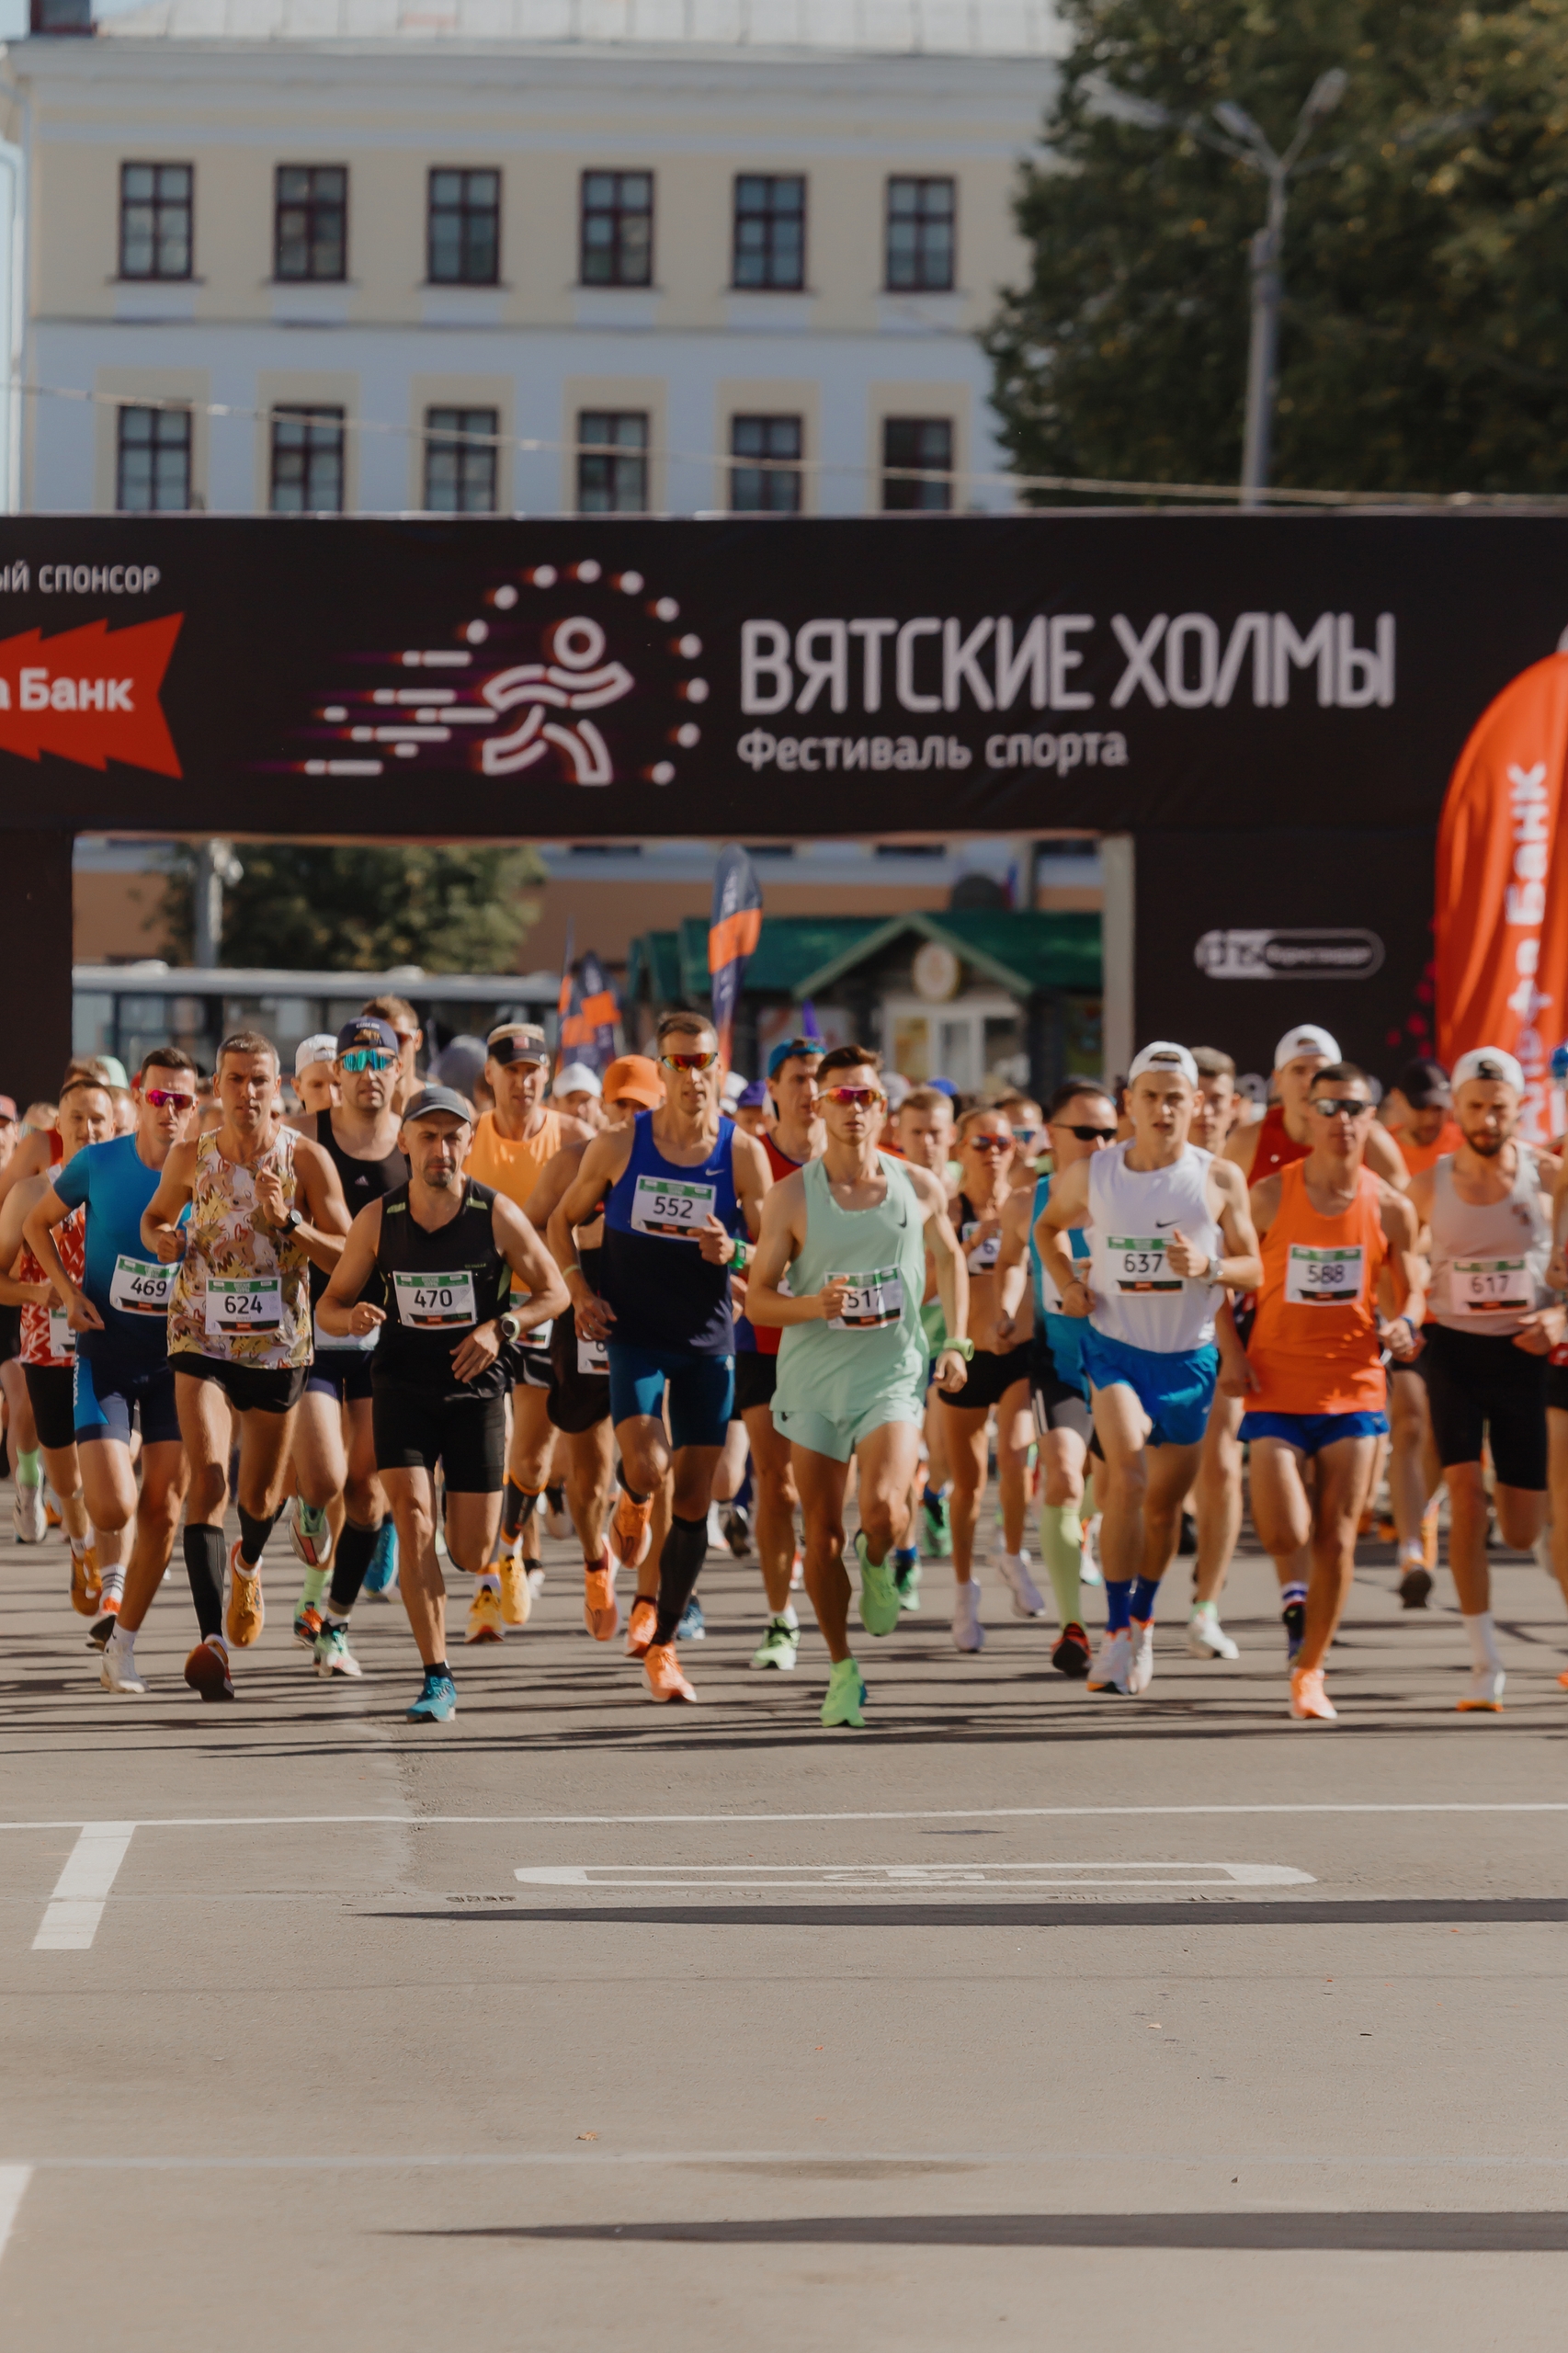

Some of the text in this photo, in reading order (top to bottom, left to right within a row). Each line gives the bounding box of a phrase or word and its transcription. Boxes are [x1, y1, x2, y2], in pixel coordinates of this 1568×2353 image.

[39, 564, 161, 594] СПОНСОР
[741, 612, 1395, 715] ВЯТСКИЕ ХОЛМЫ
[19, 667, 134, 711] Банк
[737, 727, 1129, 777] Фестиваль спорта
[1505, 762, 1550, 926] Банк
[653, 1196, 693, 1219] 552
[1124, 1254, 1163, 1272] 637
[1307, 1265, 1345, 1284] 588
[1471, 1275, 1509, 1294] 617
[131, 1277, 167, 1297] 469
[224, 1295, 263, 1314] 624
[414, 1289, 453, 1308] 470
